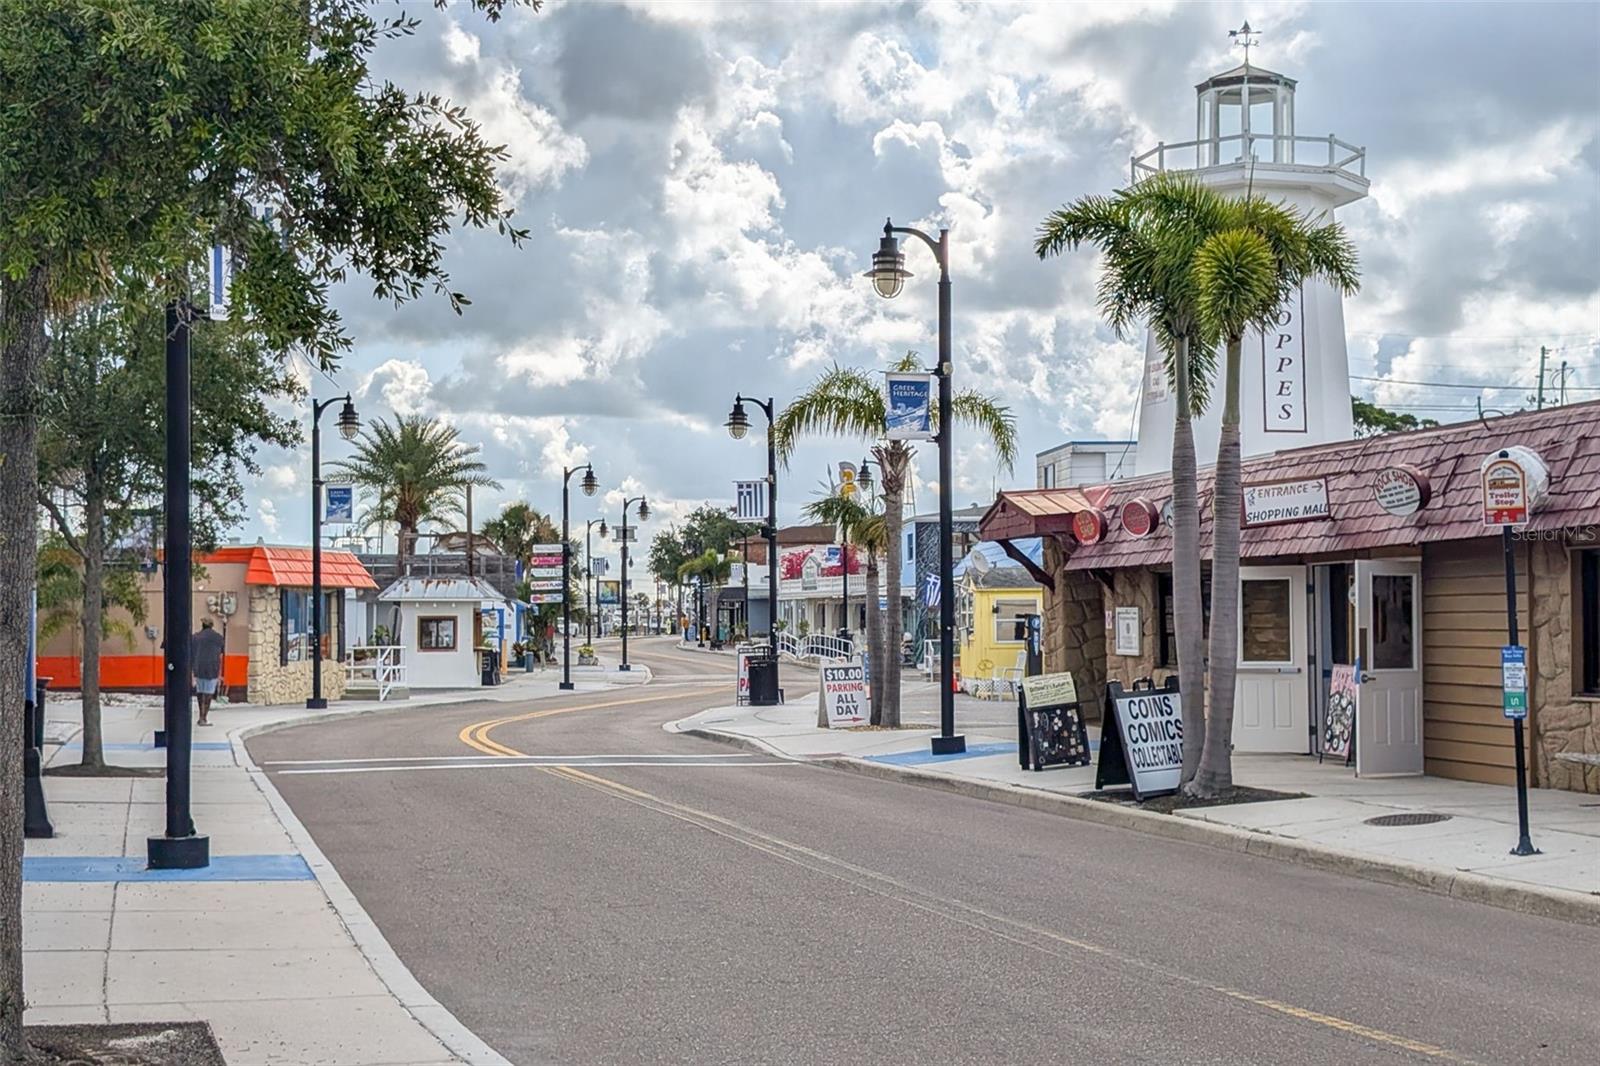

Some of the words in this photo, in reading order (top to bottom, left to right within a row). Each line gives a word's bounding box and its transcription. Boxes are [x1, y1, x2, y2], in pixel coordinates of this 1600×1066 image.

[1275, 310, 1293, 420] OPPES
[1391, 471, 1415, 487] SHOP
[1257, 484, 1309, 498] ENTRANCE
[1489, 492, 1520, 501] Trolley
[1495, 499, 1515, 507] Stop
[1246, 507, 1300, 522] SHOPPING
[1302, 503, 1330, 515] MALL
[826, 668, 862, 681] $10.00
[827, 682, 863, 693] PARKING
[837, 693, 857, 705] ALL
[836, 704, 860, 716] DAY
[1128, 696, 1173, 720] COINS
[1128, 718, 1184, 744] COMICS
[1132, 743, 1183, 768] COLLECTABL
